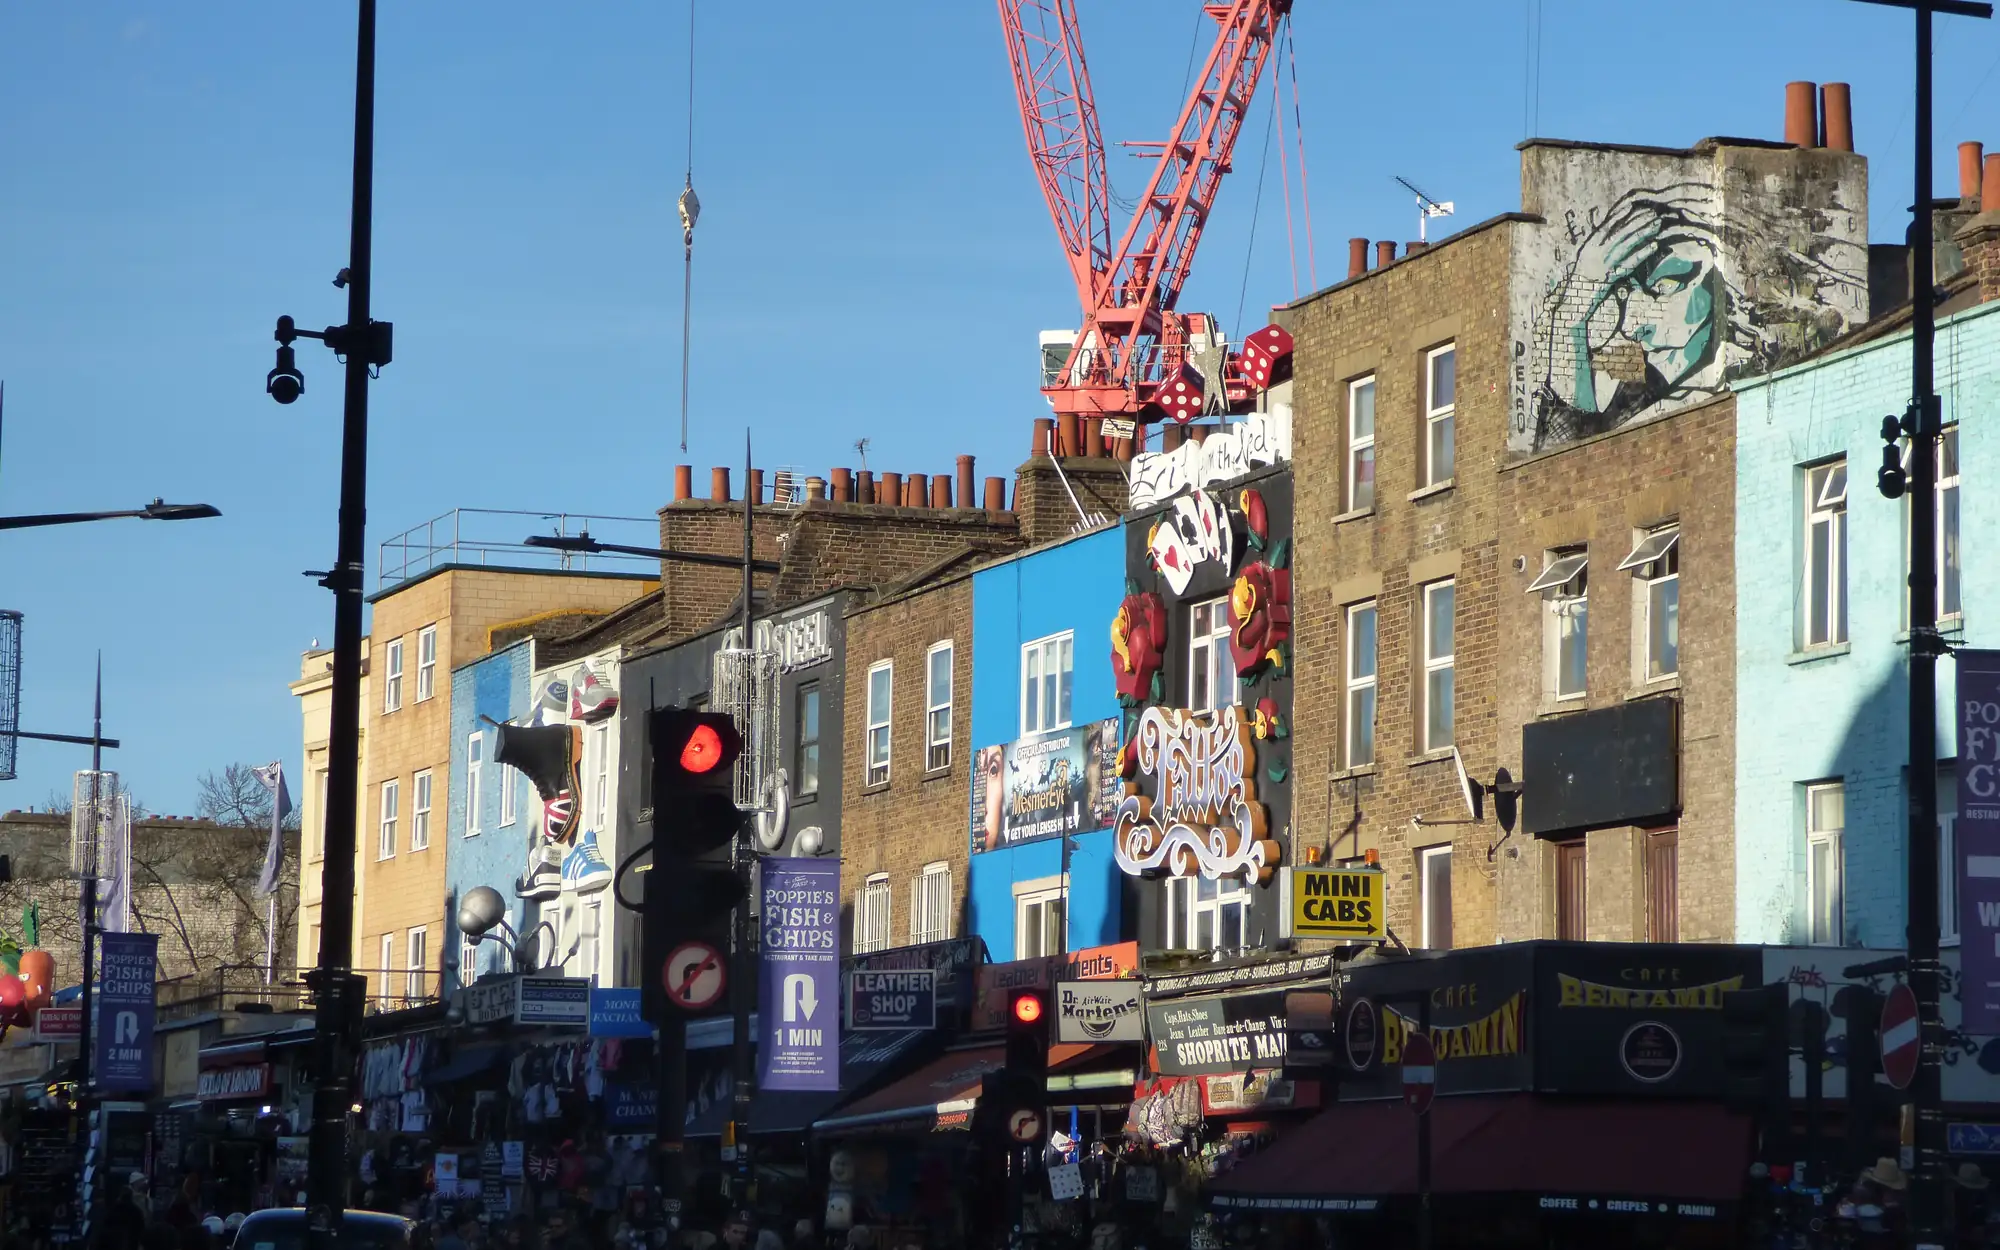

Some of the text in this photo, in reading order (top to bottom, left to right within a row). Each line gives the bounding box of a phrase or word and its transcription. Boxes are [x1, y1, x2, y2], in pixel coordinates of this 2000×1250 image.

[1017, 736, 1071, 761] OFFICIAL DISTRIBUTOR
[1010, 826, 1022, 841] GET
[1022, 823, 1037, 838] YOUR
[1037, 819, 1058, 836] LENSES
[1304, 874, 1370, 897] MINI
[766, 889, 834, 904] POPPIE'S
[765, 905, 834, 926] FISH &
[1303, 899, 1372, 922] CABS
[765, 927, 834, 948] CHIPS
[106, 954, 152, 965] POPPIE'S
[805, 954, 818, 962] TAKE
[105, 964, 142, 980] FISH
[1252, 962, 1286, 979] SUNGLASSES
[1288, 960, 1304, 974] BODY
[1620, 968, 1682, 982] CAFE
[104, 980, 152, 995] CHIPS
[855, 973, 932, 992] LEATHER
[871, 994, 917, 1014] SHOP
[1062, 997, 1138, 1019] Martens
[774, 1029, 822, 1046] 1 MIN
[1169, 1027, 1184, 1040] Jeans
[1188, 1024, 1209, 1038] Leather
[109, 1048, 142, 1061] 2 MIN
[1177, 1036, 1251, 1066] SHOPRITE
[1539, 1196, 1717, 1217] COFFEE CREPES PANINI
